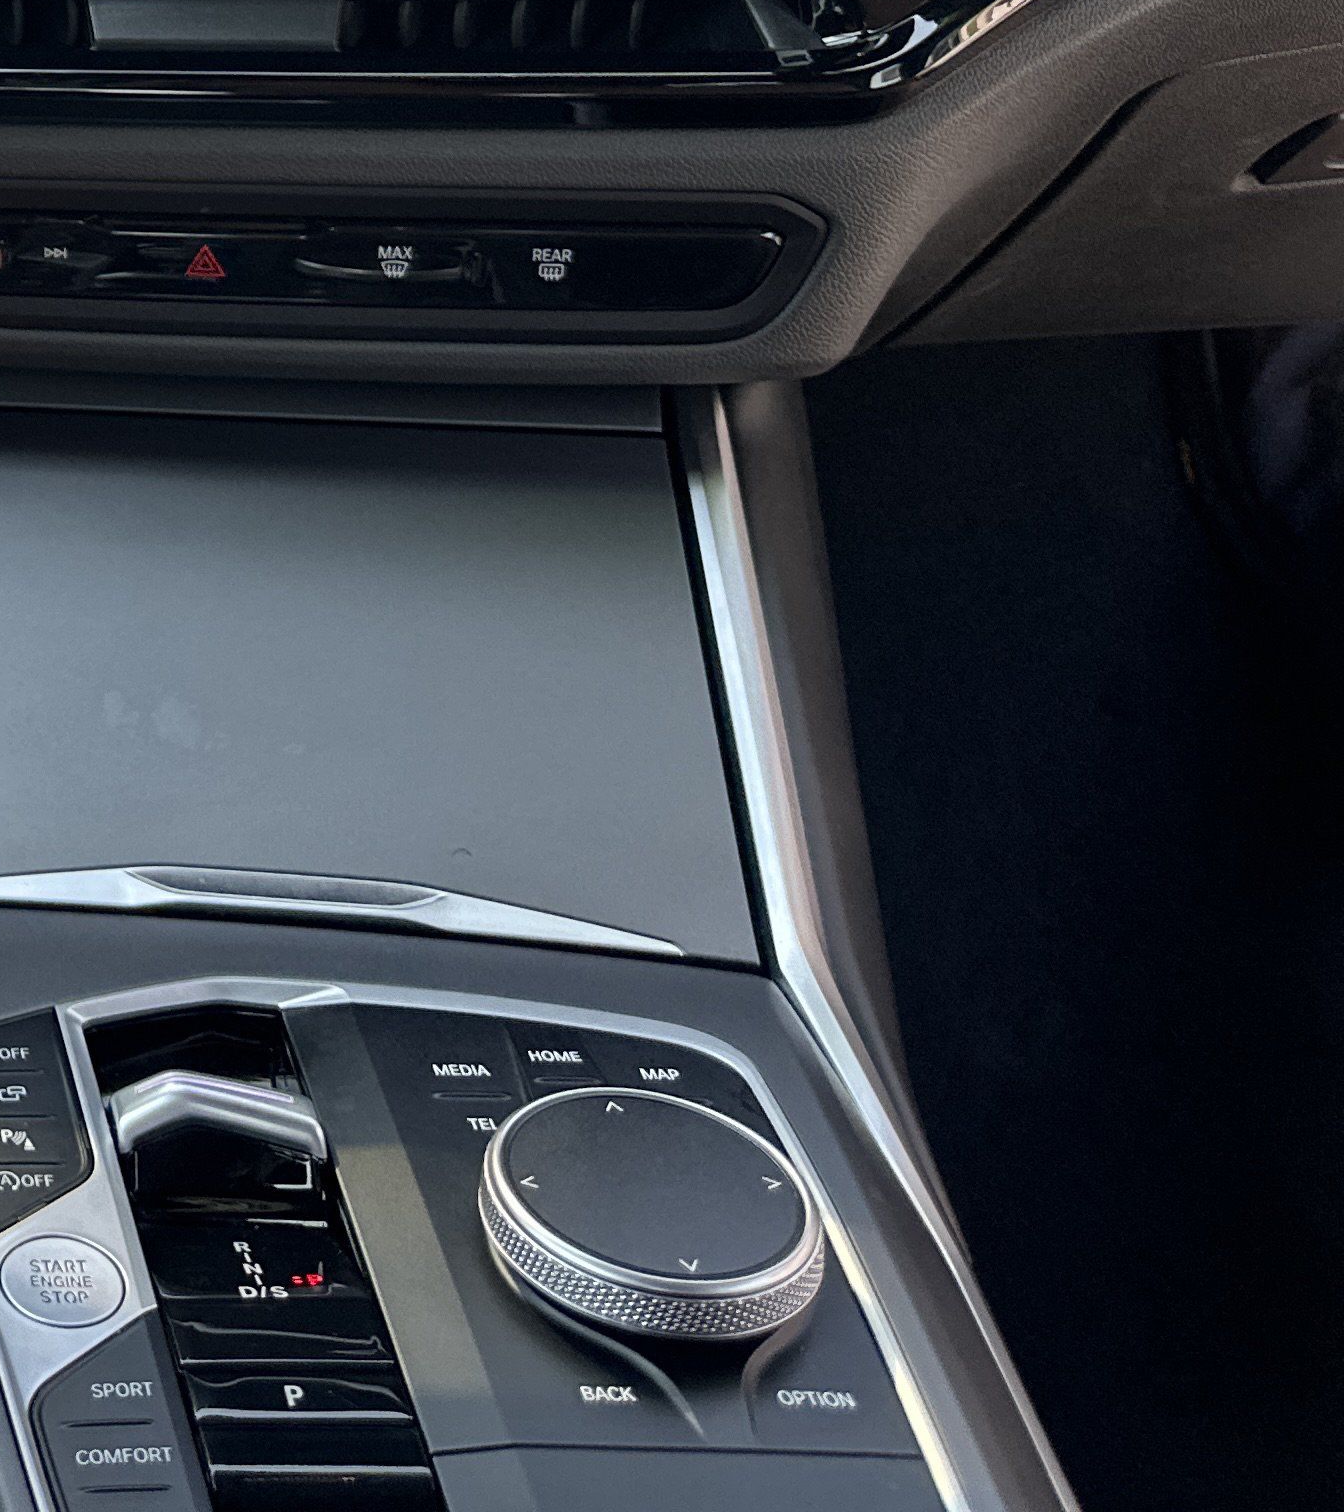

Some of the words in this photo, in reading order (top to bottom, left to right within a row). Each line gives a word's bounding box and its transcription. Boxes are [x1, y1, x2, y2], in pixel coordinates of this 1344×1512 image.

[378, 245, 413, 260] MAX
[532, 248, 572, 263] REAR
[527, 1049, 583, 1064] HOME
[432, 1062, 491, 1079] MEDIA
[639, 1066, 681, 1083] MAP
[21, 1174, 54, 1188] OFF
[233, 1241, 252, 1253] R
[30, 1258, 87, 1273] START
[243, 1263, 264, 1275] N
[30, 1274, 94, 1289] ENGINE
[40, 1290, 89, 1304] STOP
[90, 1381, 153, 1400] SPORT
[284, 1385, 304, 1407] P
[579, 1384, 637, 1404] BACK
[776, 1389, 857, 1410] OPTION
[75, 1446, 173, 1466] COMFORT
